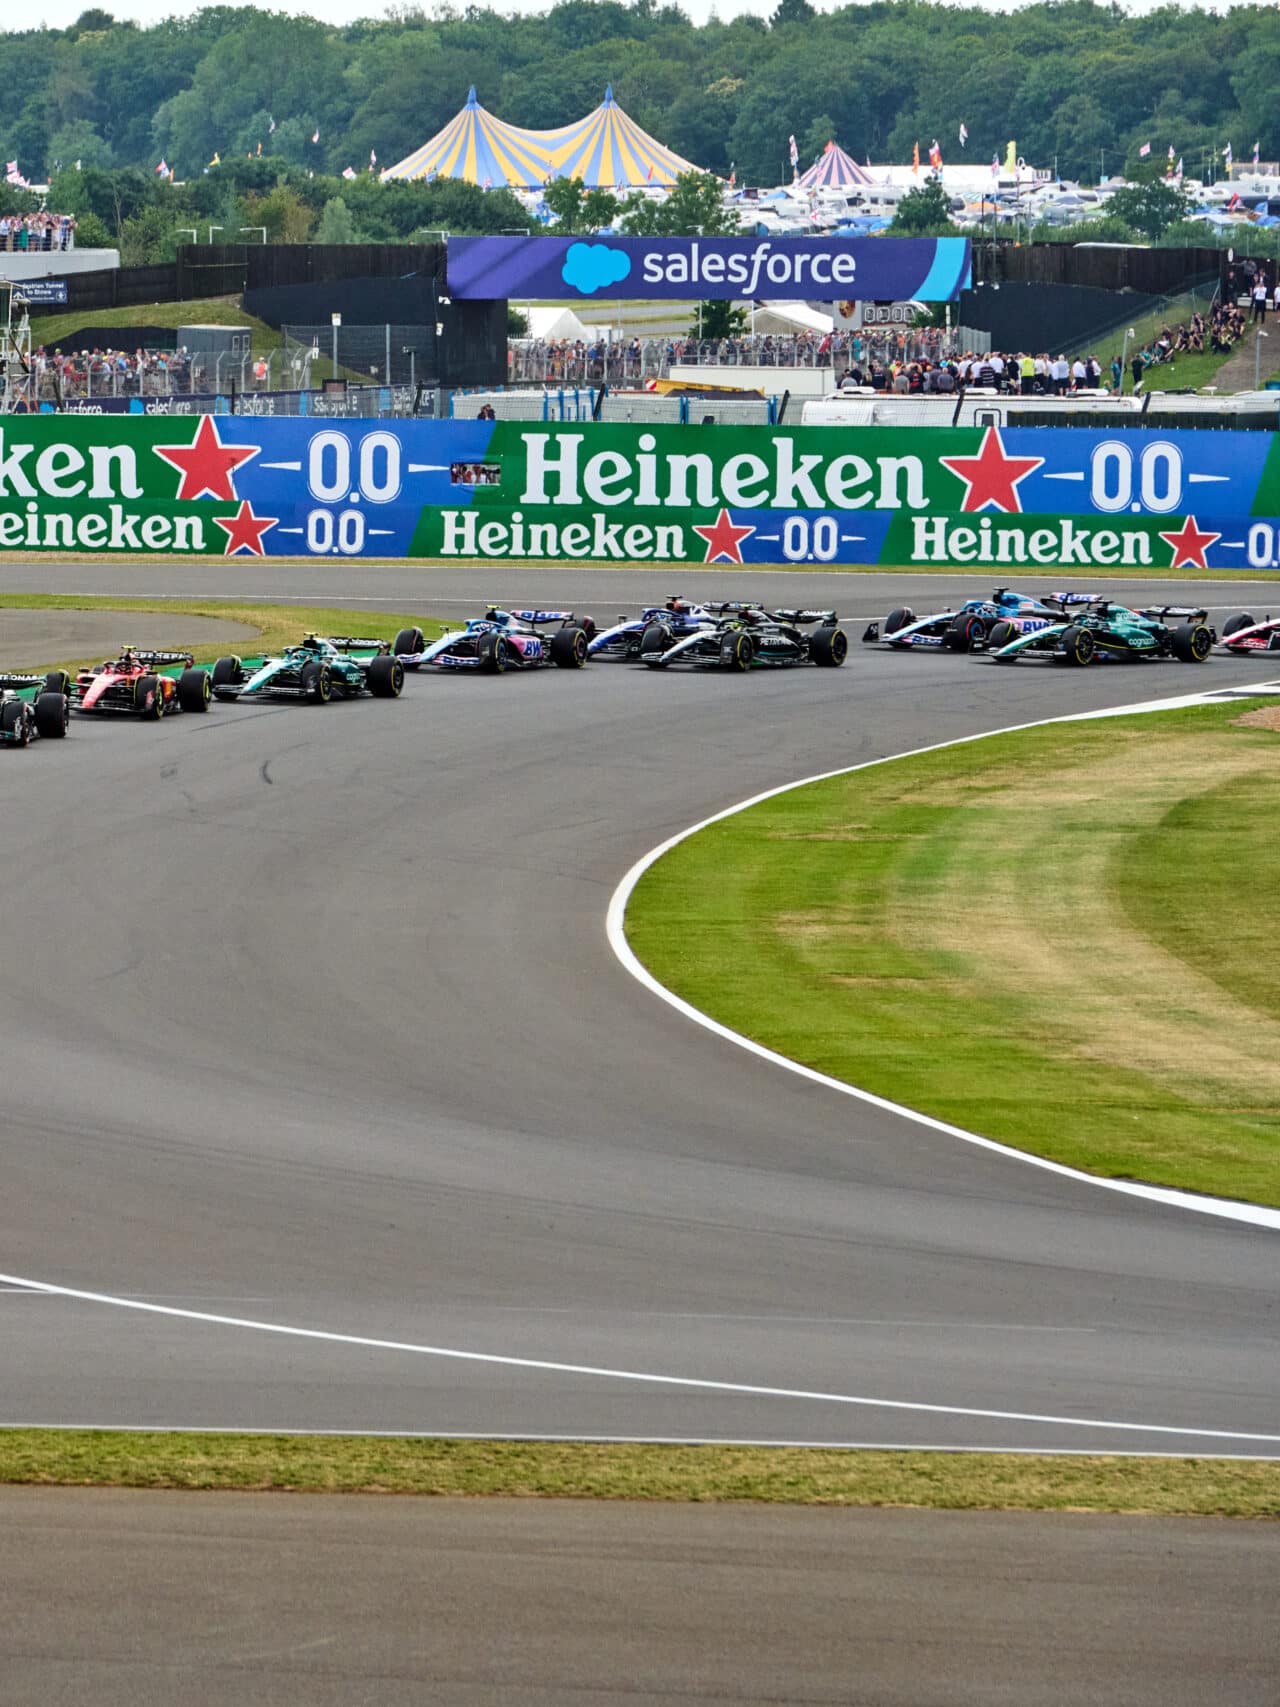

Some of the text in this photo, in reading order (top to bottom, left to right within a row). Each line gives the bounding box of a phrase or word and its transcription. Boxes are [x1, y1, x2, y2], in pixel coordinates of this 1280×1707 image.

[643, 242, 856, 295] salesforce
[307, 429, 404, 504] 0.0
[520, 433, 1184, 513] Heineken 0.0
[306, 507, 367, 554] 0.0
[440, 510, 839, 562] Heineken 0.0
[910, 516, 1280, 568] Heineken 0.
